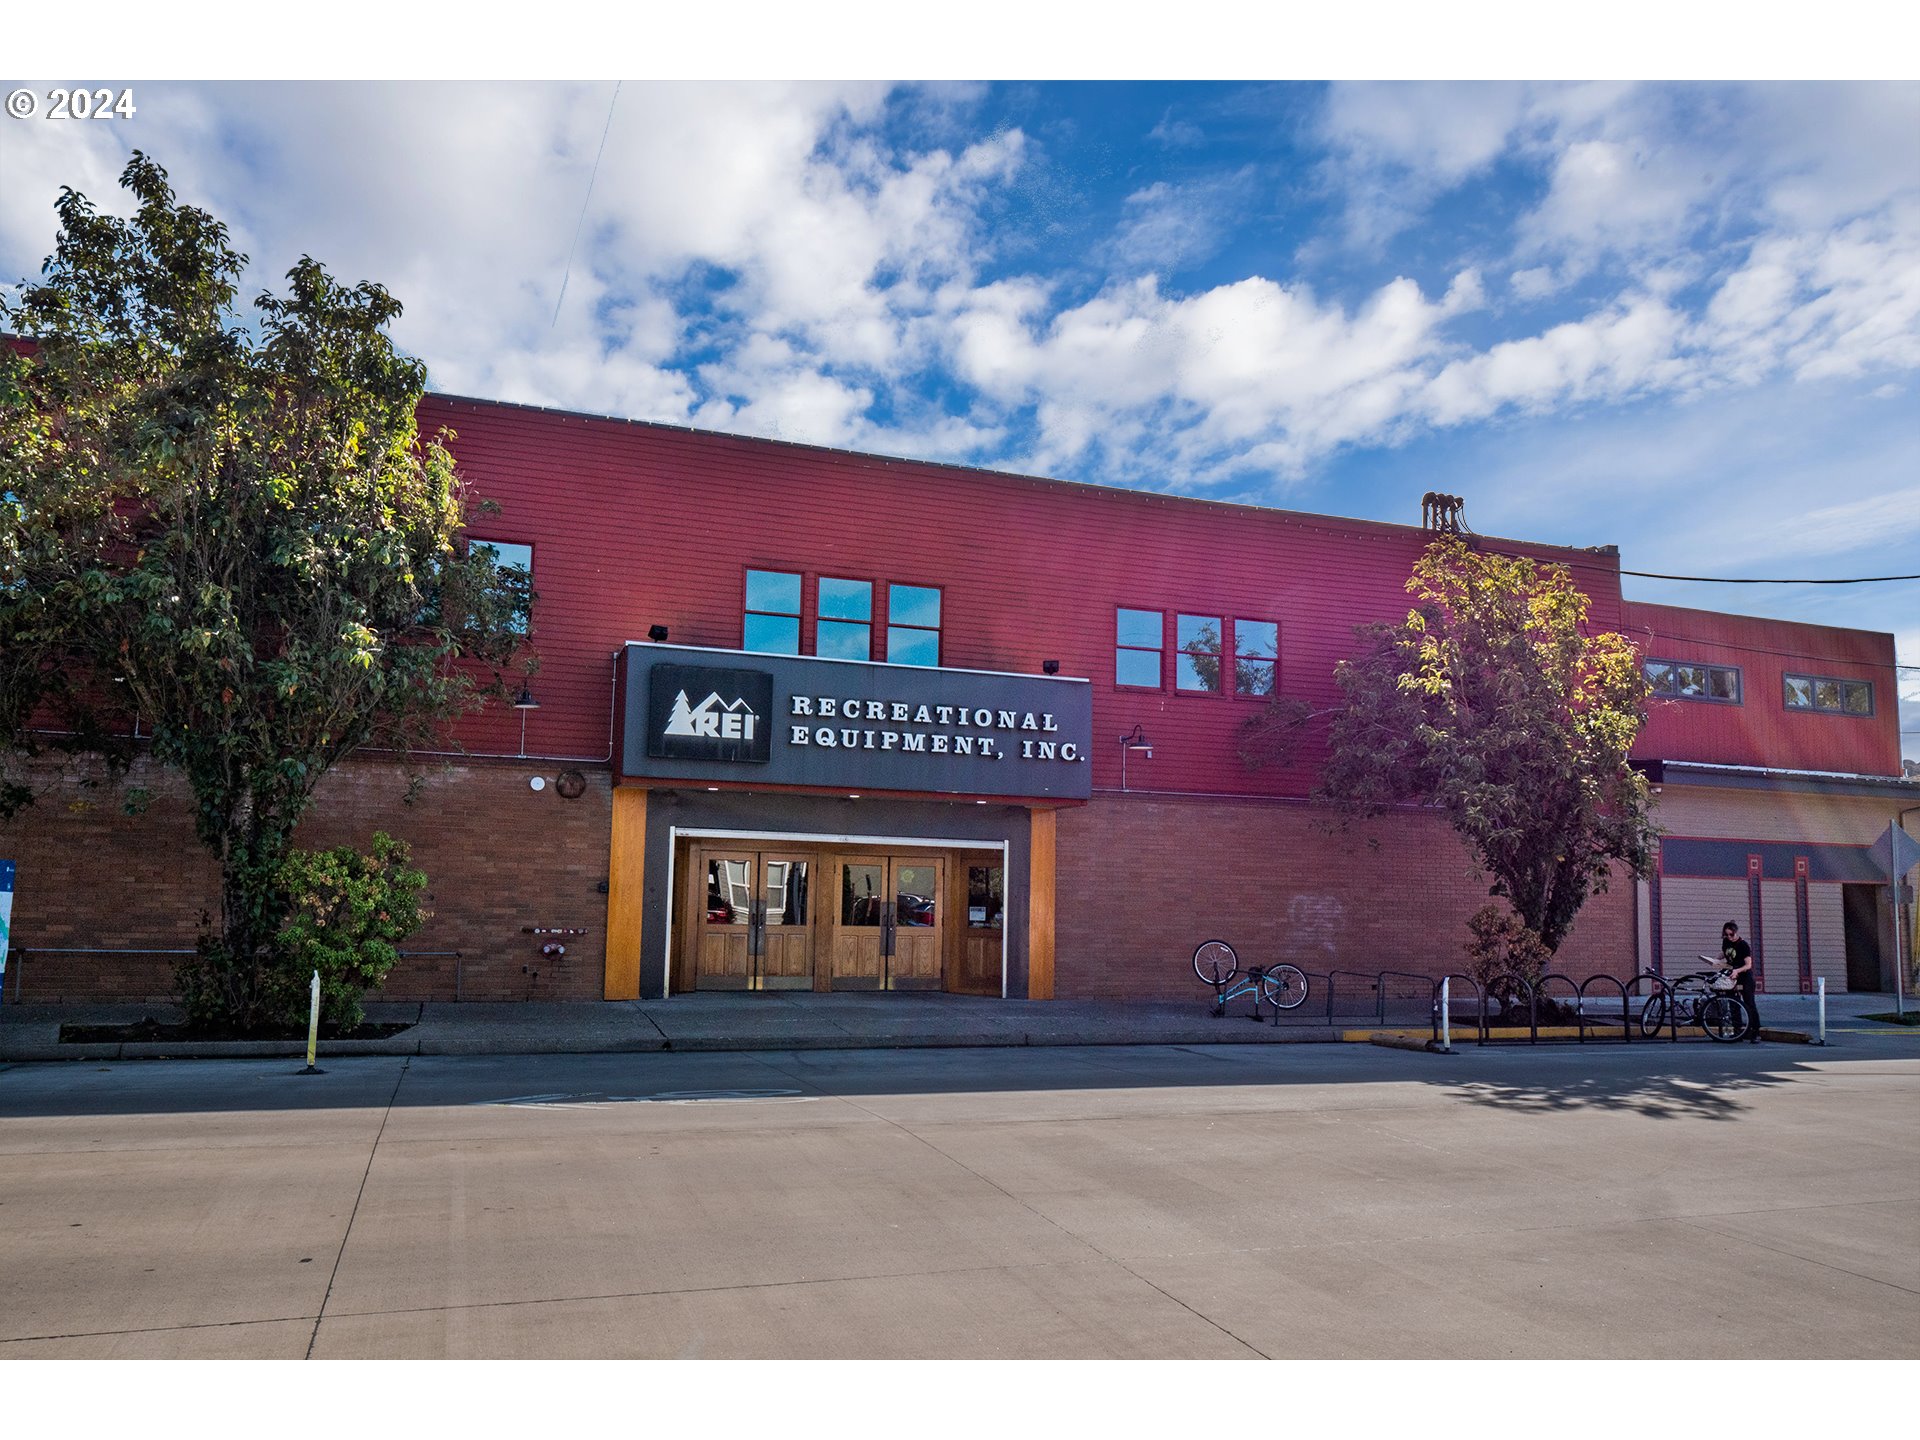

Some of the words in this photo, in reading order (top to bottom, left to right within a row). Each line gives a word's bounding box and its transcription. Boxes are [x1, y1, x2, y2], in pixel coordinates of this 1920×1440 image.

[695, 711, 754, 740] REI
[791, 696, 1058, 732] RECREATIONAL
[790, 725, 1004, 760] EQUIPMENT,
[1022, 740, 1086, 762] INC.
